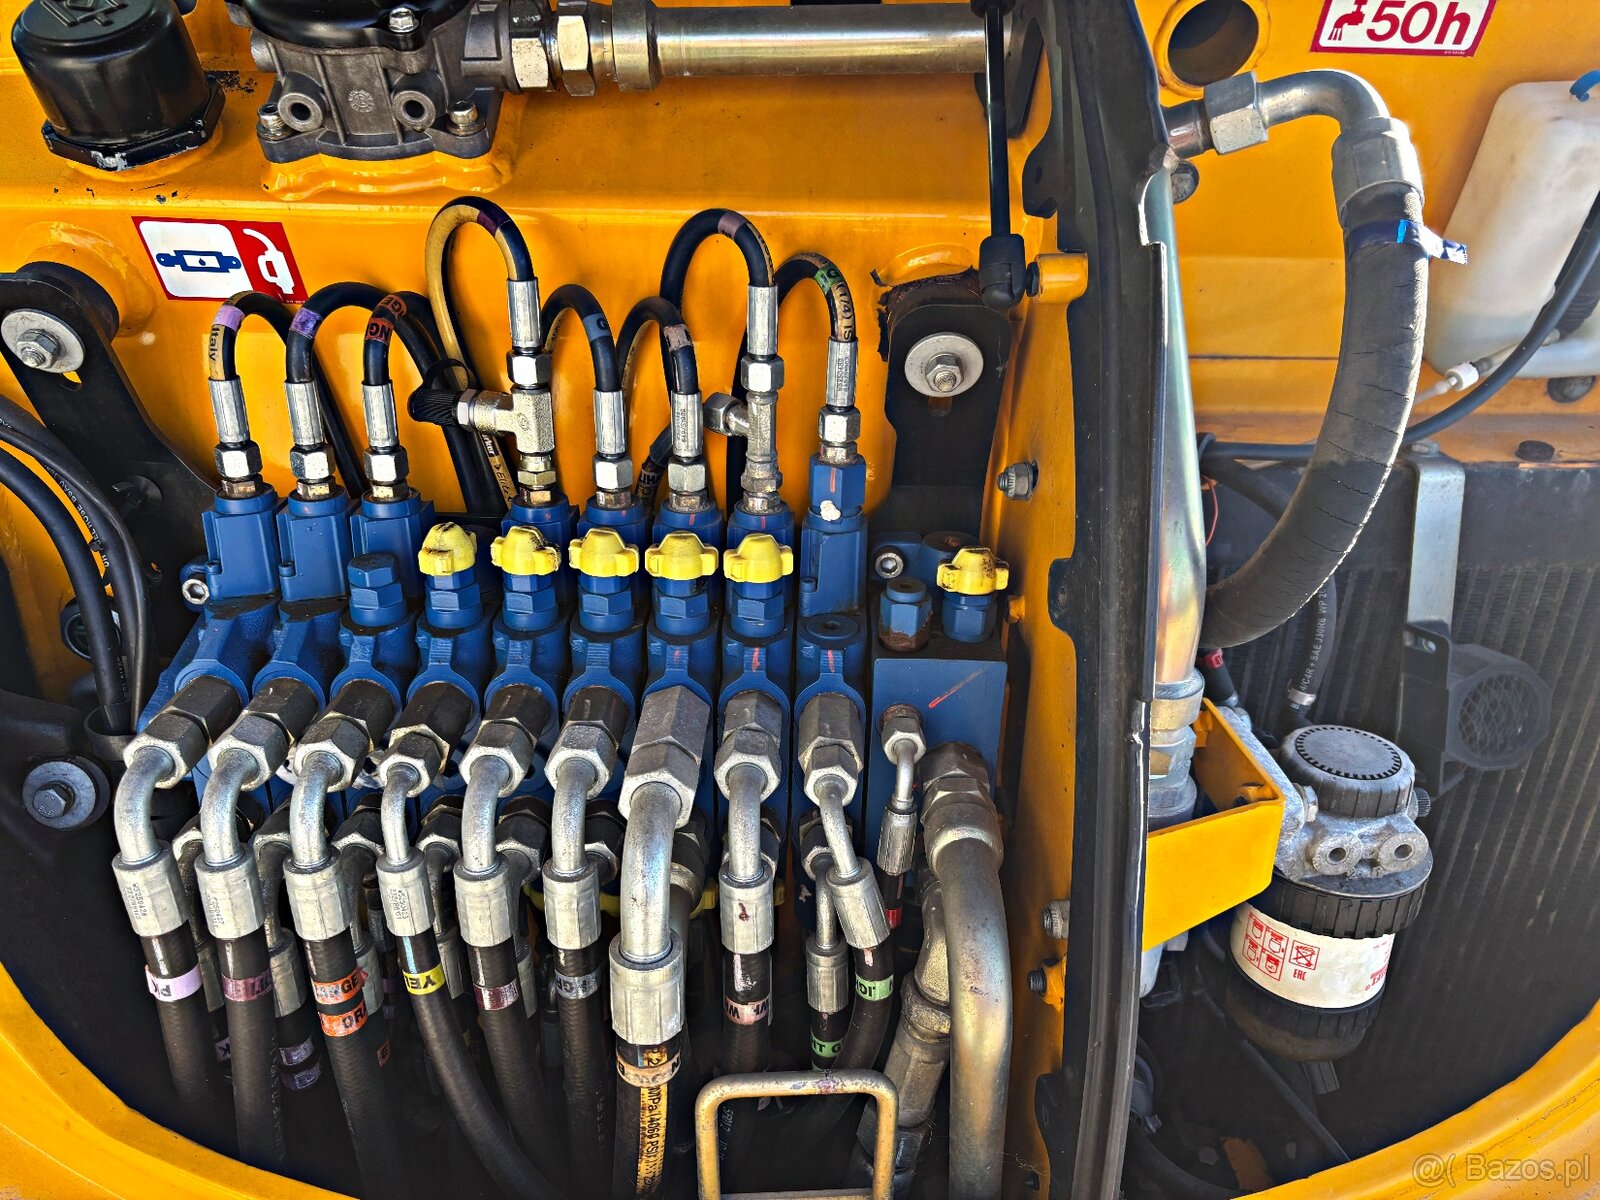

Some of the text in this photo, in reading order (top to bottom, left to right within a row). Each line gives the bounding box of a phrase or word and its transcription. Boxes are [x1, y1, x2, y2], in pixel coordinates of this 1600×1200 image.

[1366, 1, 1471, 45] 50h
[208, 327, 220, 361] Italy
[1309, 644, 1322, 662] SAE
